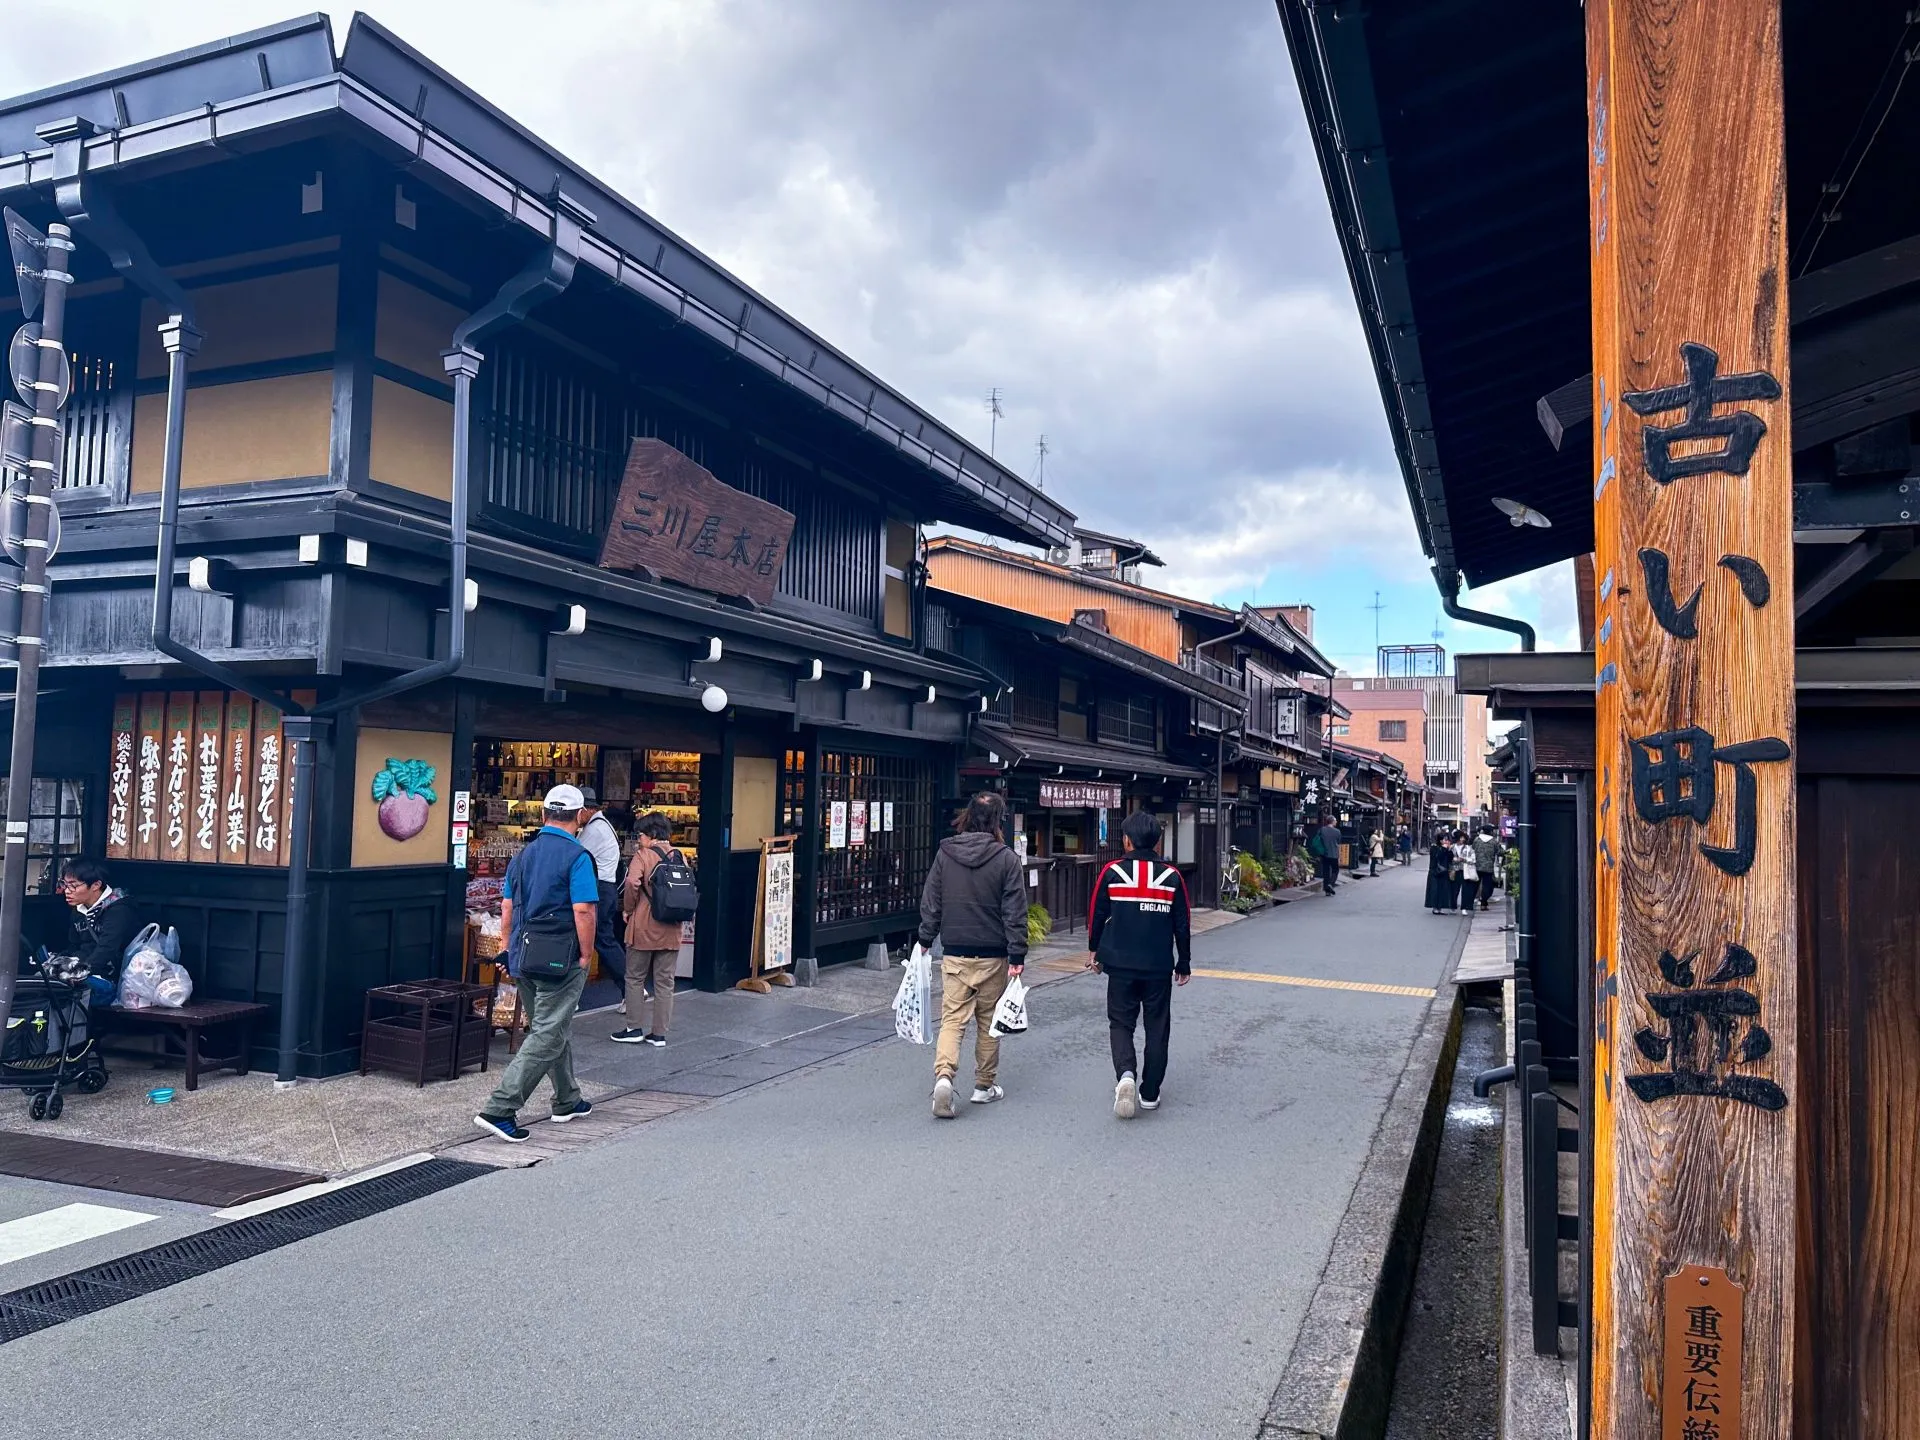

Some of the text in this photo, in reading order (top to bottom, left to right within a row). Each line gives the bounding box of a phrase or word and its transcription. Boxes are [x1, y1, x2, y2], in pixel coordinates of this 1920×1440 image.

[621, 490, 781, 577] 三川屋本店
[1621, 341, 1791, 1112] 古い町並
[110, 732, 132, 847] 総合みやげ処
[138, 735, 161, 844] 駄菓子
[168, 730, 188, 848] 赤かぶら
[196, 732, 219, 850] 朴葉みそ
[226, 774, 245, 853] 山菜
[1305, 778, 1319, 804] 旅館
[769, 867, 780, 903] 地酒
[1139, 903, 1171, 913] ENGLAND
